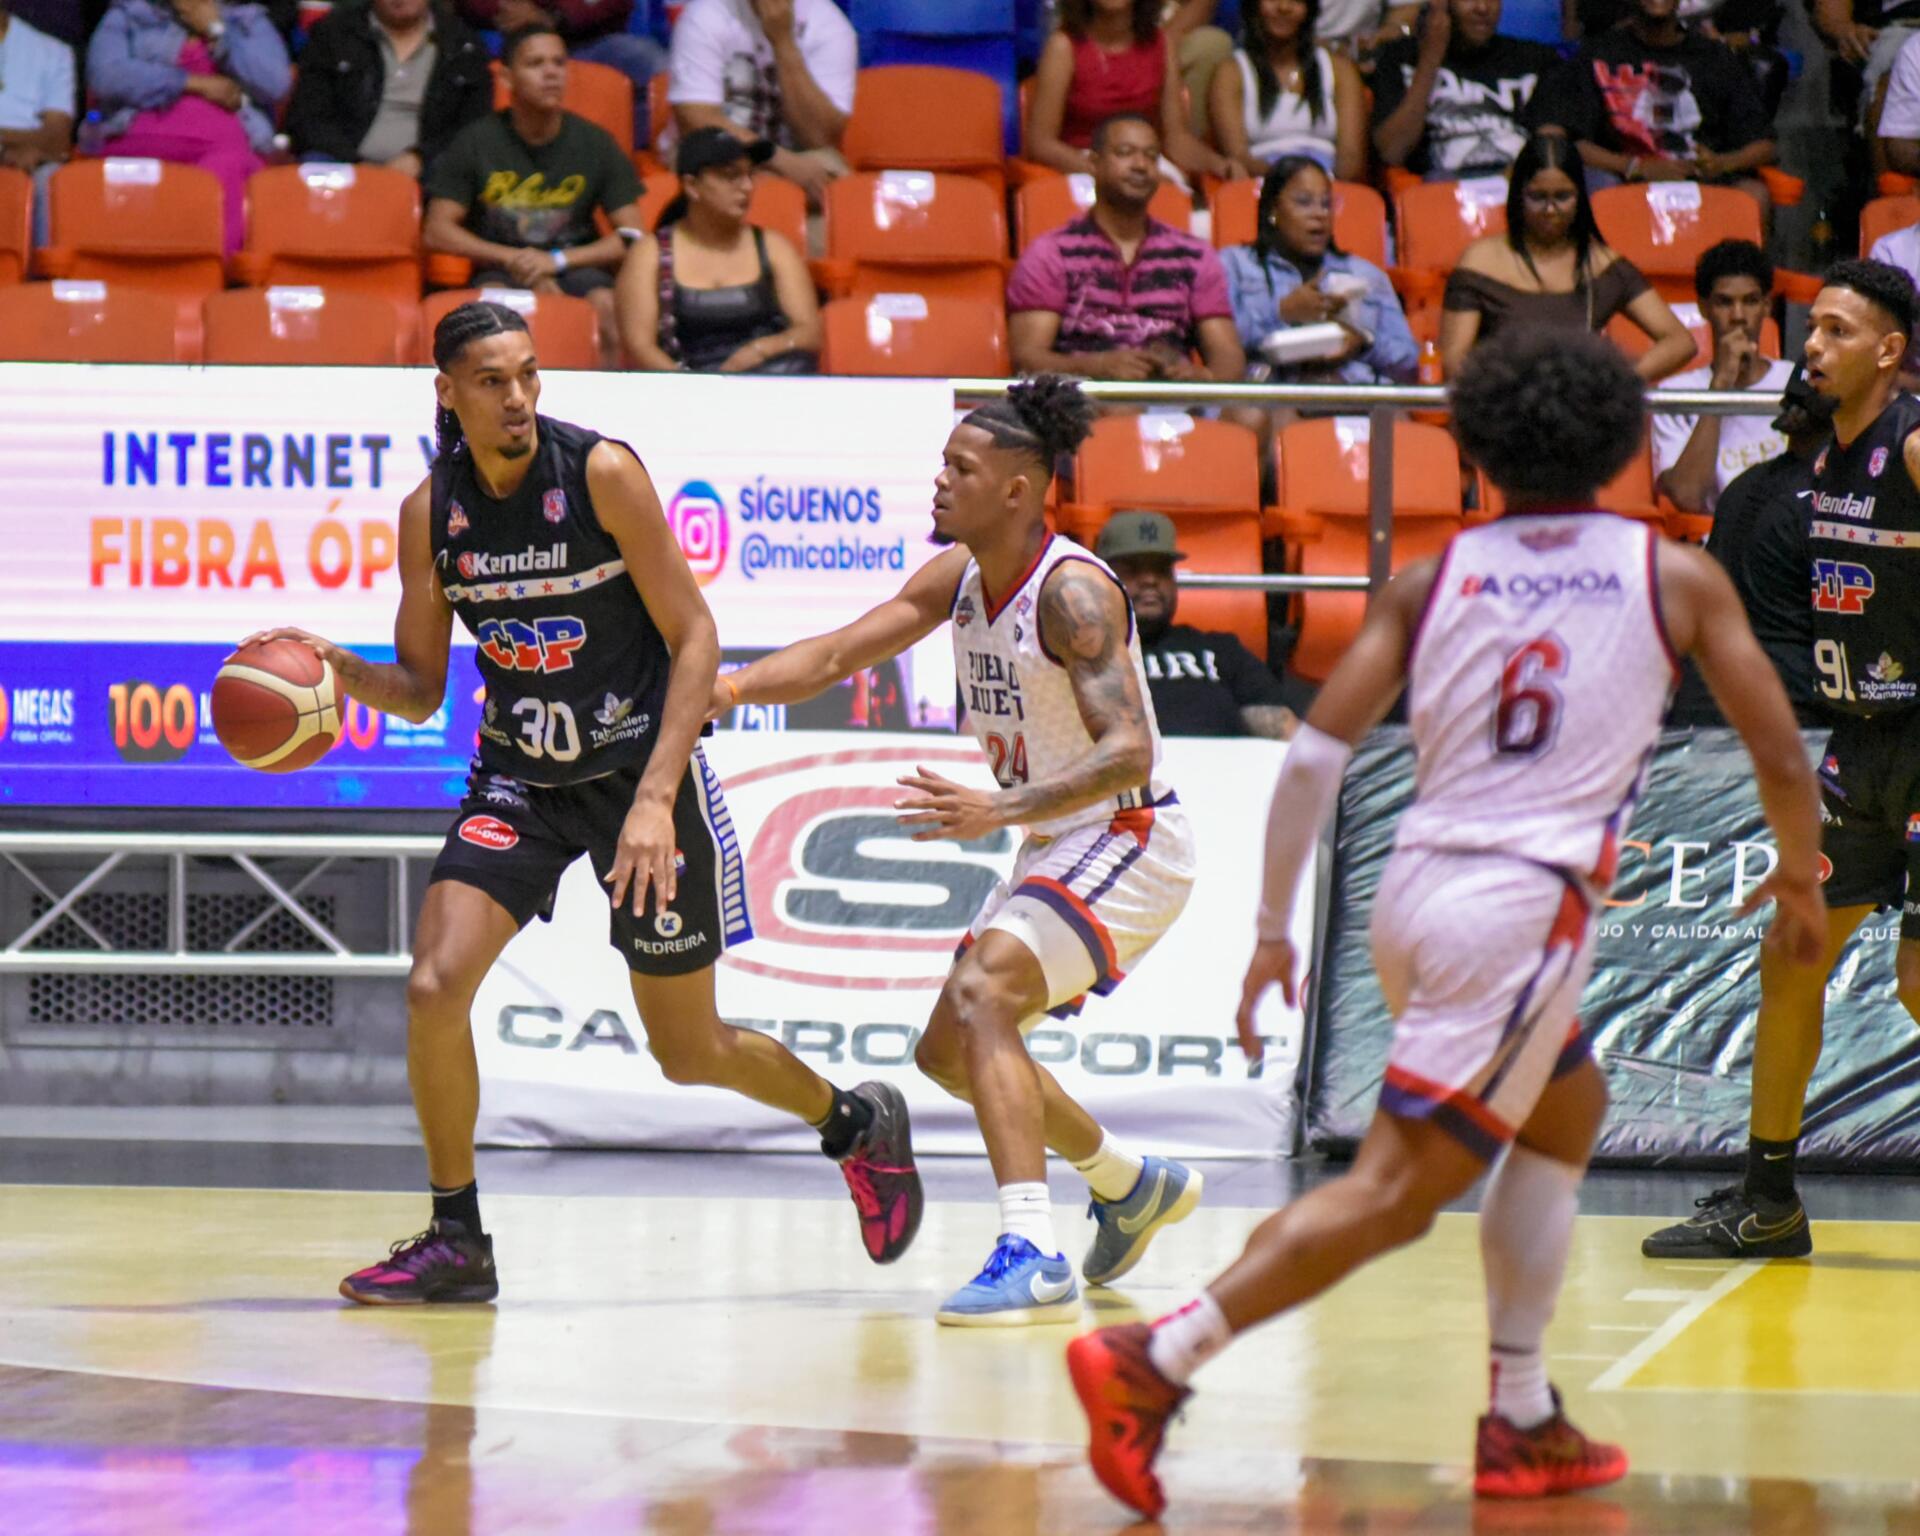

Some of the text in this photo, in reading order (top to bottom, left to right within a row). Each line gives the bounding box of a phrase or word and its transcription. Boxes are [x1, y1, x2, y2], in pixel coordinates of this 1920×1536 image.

[103, 431, 391, 489] INTERNET
[740, 475, 881, 523] SÍGUENOS
[91, 517, 285, 588] FIBRA
[473, 542, 567, 577] Kendall
[741, 533, 905, 579] @micablerd
[1811, 558, 1875, 615] DP
[1496, 633, 1572, 758] 6
[1813, 639, 1857, 702] 91
[1858, 680, 1917, 692] Tabacalera
[13, 688, 74, 726] MEGAS
[108, 683, 196, 749] 100
[511, 697, 582, 762] 30
[986, 731, 1030, 790] 24
[634, 931, 707, 955] PEDREIRA
[1631, 925, 1645, 938] Y
[1651, 924, 1738, 939] CALIDAD
